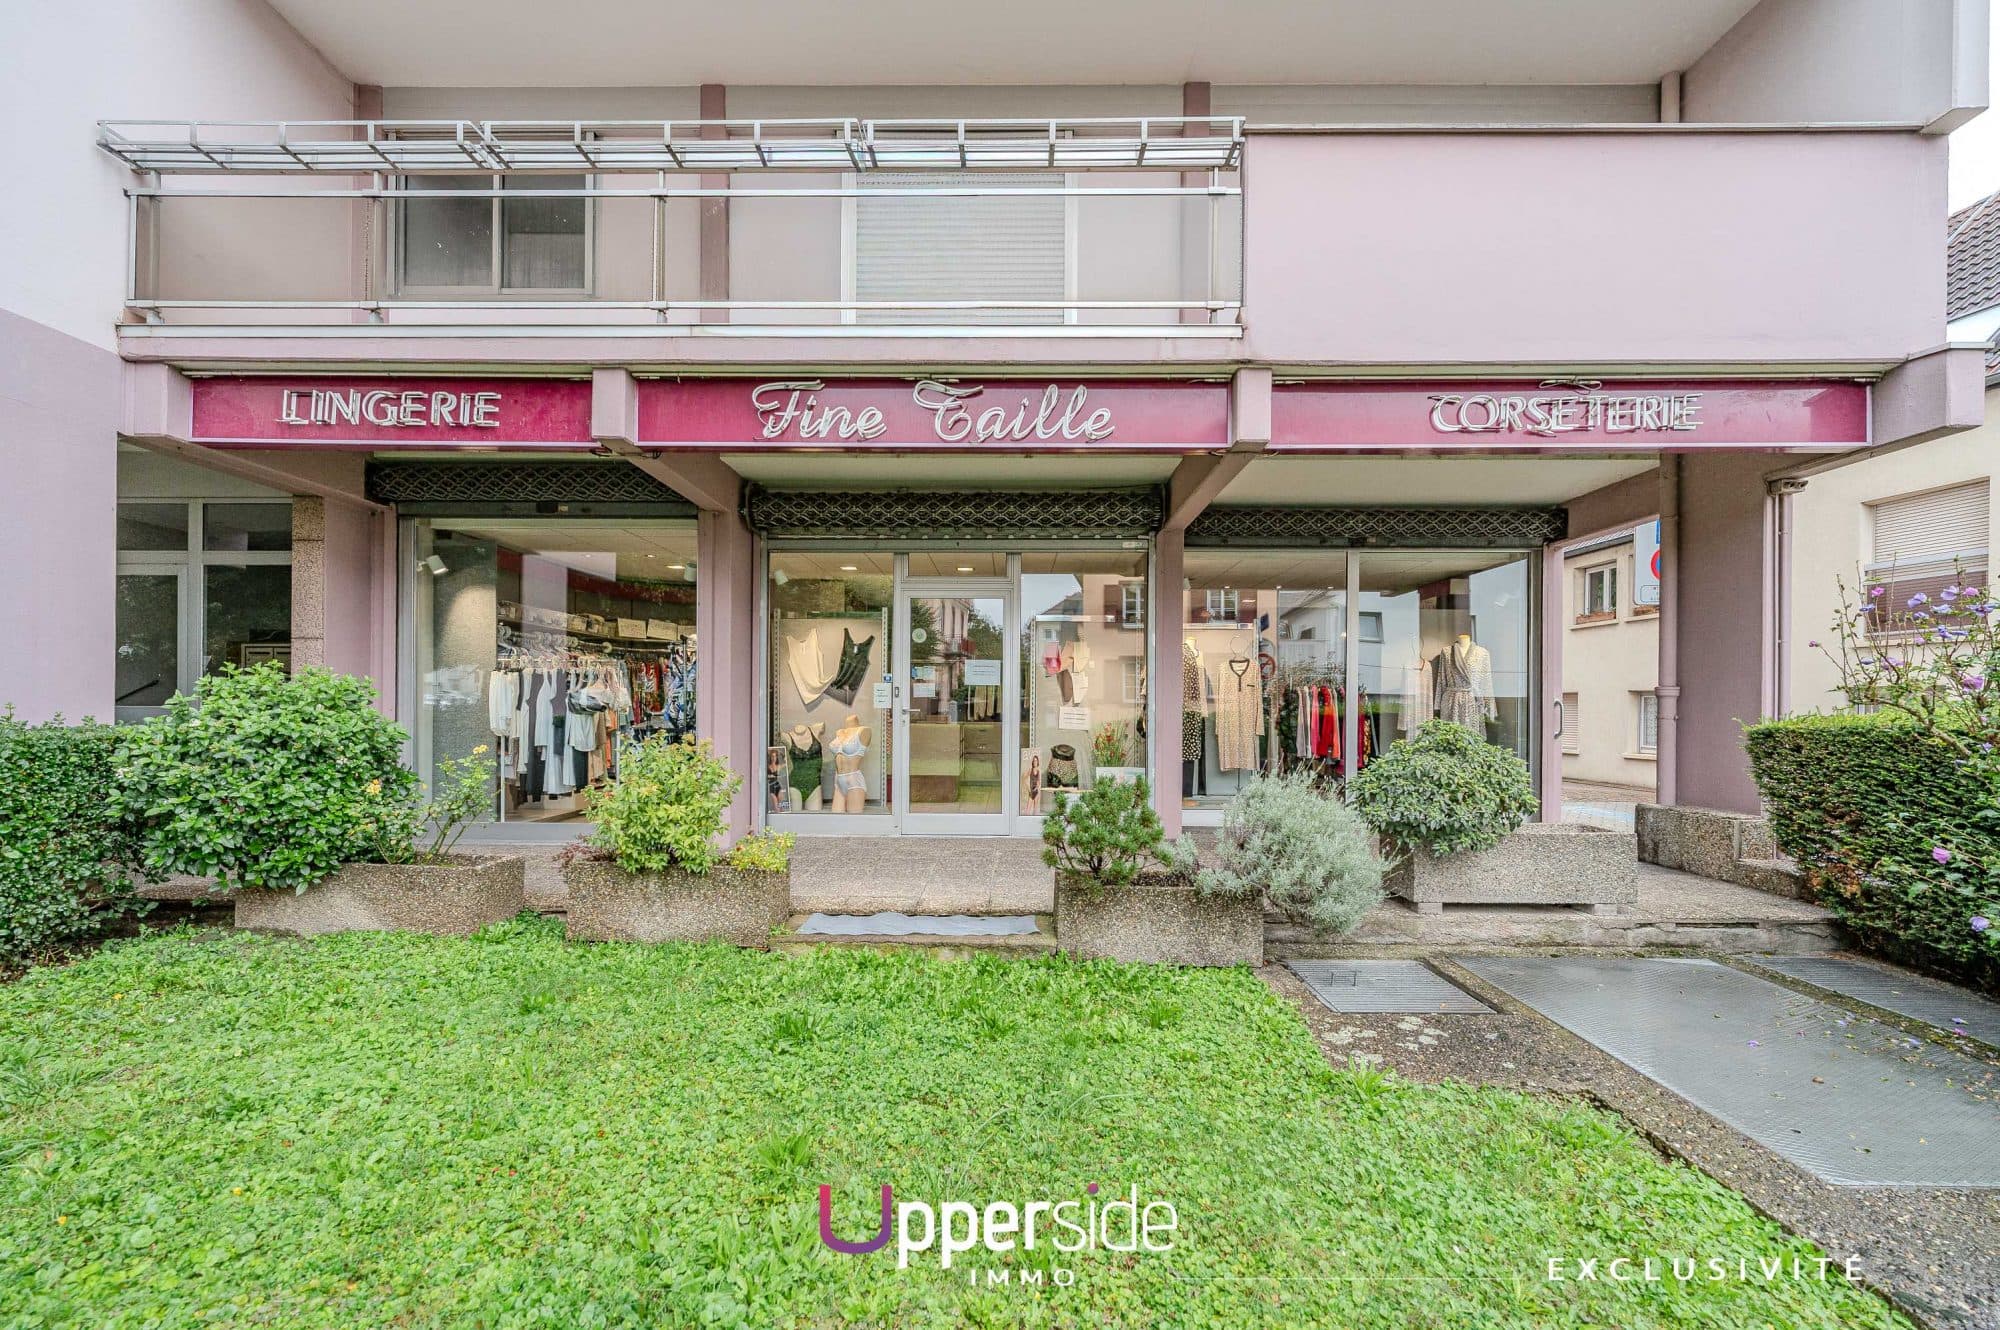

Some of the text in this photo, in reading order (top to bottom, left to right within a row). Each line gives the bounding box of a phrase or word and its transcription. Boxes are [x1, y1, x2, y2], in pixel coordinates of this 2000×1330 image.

[280, 388, 502, 426] LINGERIE
[751, 379, 1116, 443] Fine Taille
[1429, 391, 1704, 434] CORSETERIE
